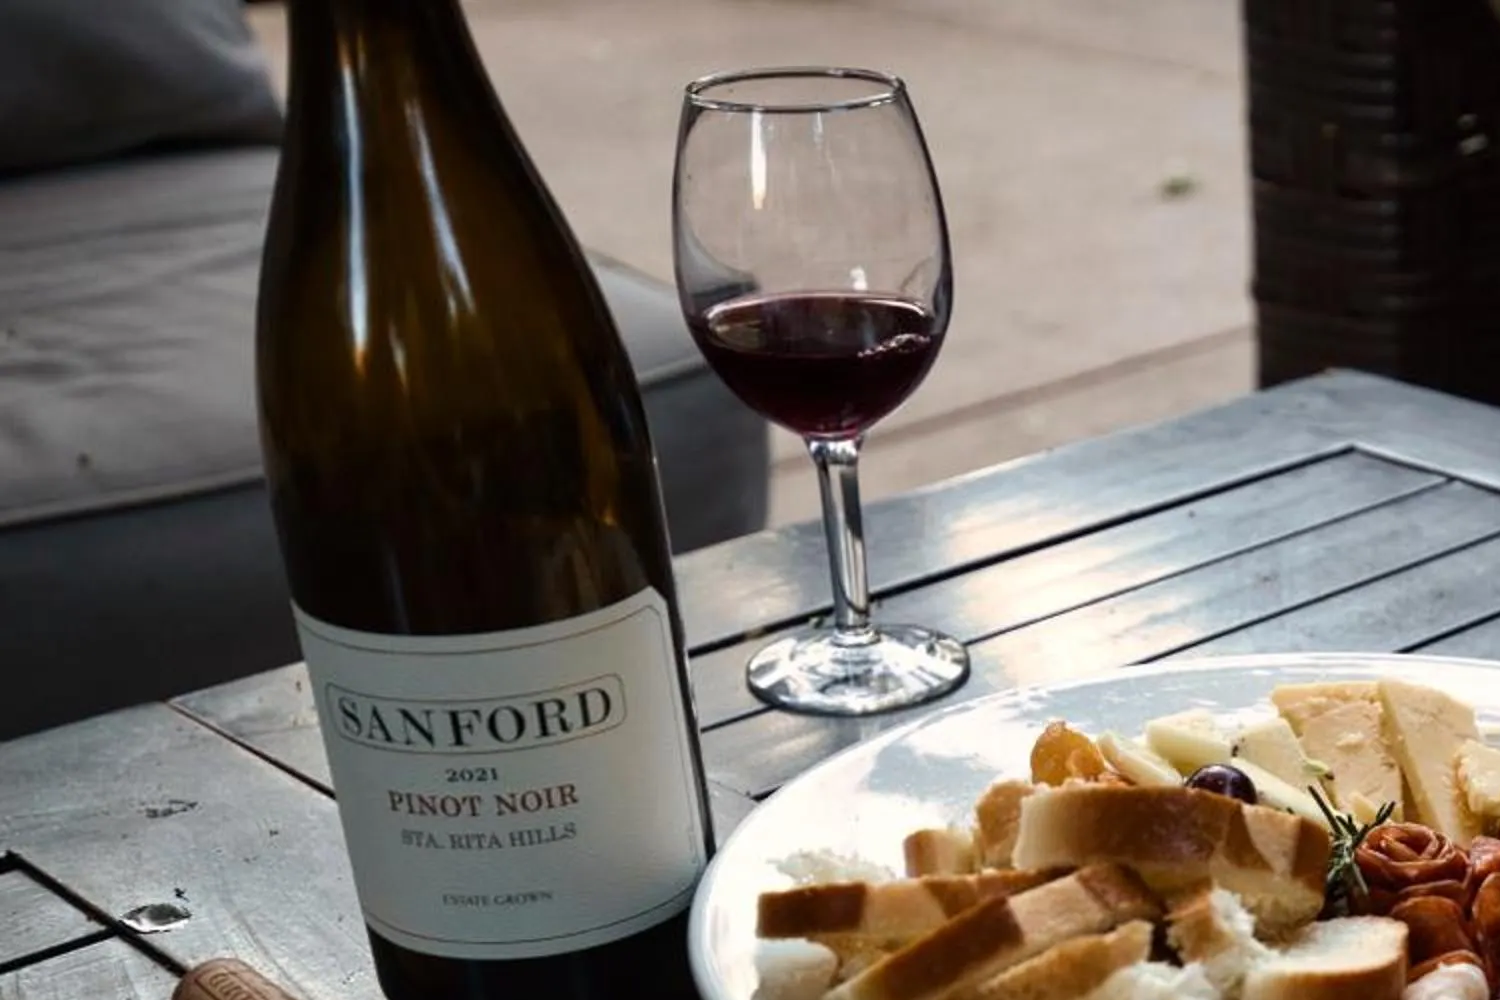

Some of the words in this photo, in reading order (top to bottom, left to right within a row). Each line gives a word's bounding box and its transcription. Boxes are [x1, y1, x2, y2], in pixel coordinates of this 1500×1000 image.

[338, 686, 612, 747] SANFORD
[445, 767, 499, 782] 2021
[388, 789, 481, 817] PINOT
[496, 783, 579, 816] NOIR
[401, 828, 443, 849] STA.
[449, 833, 503, 850] RITA
[509, 822, 577, 848] HILLS
